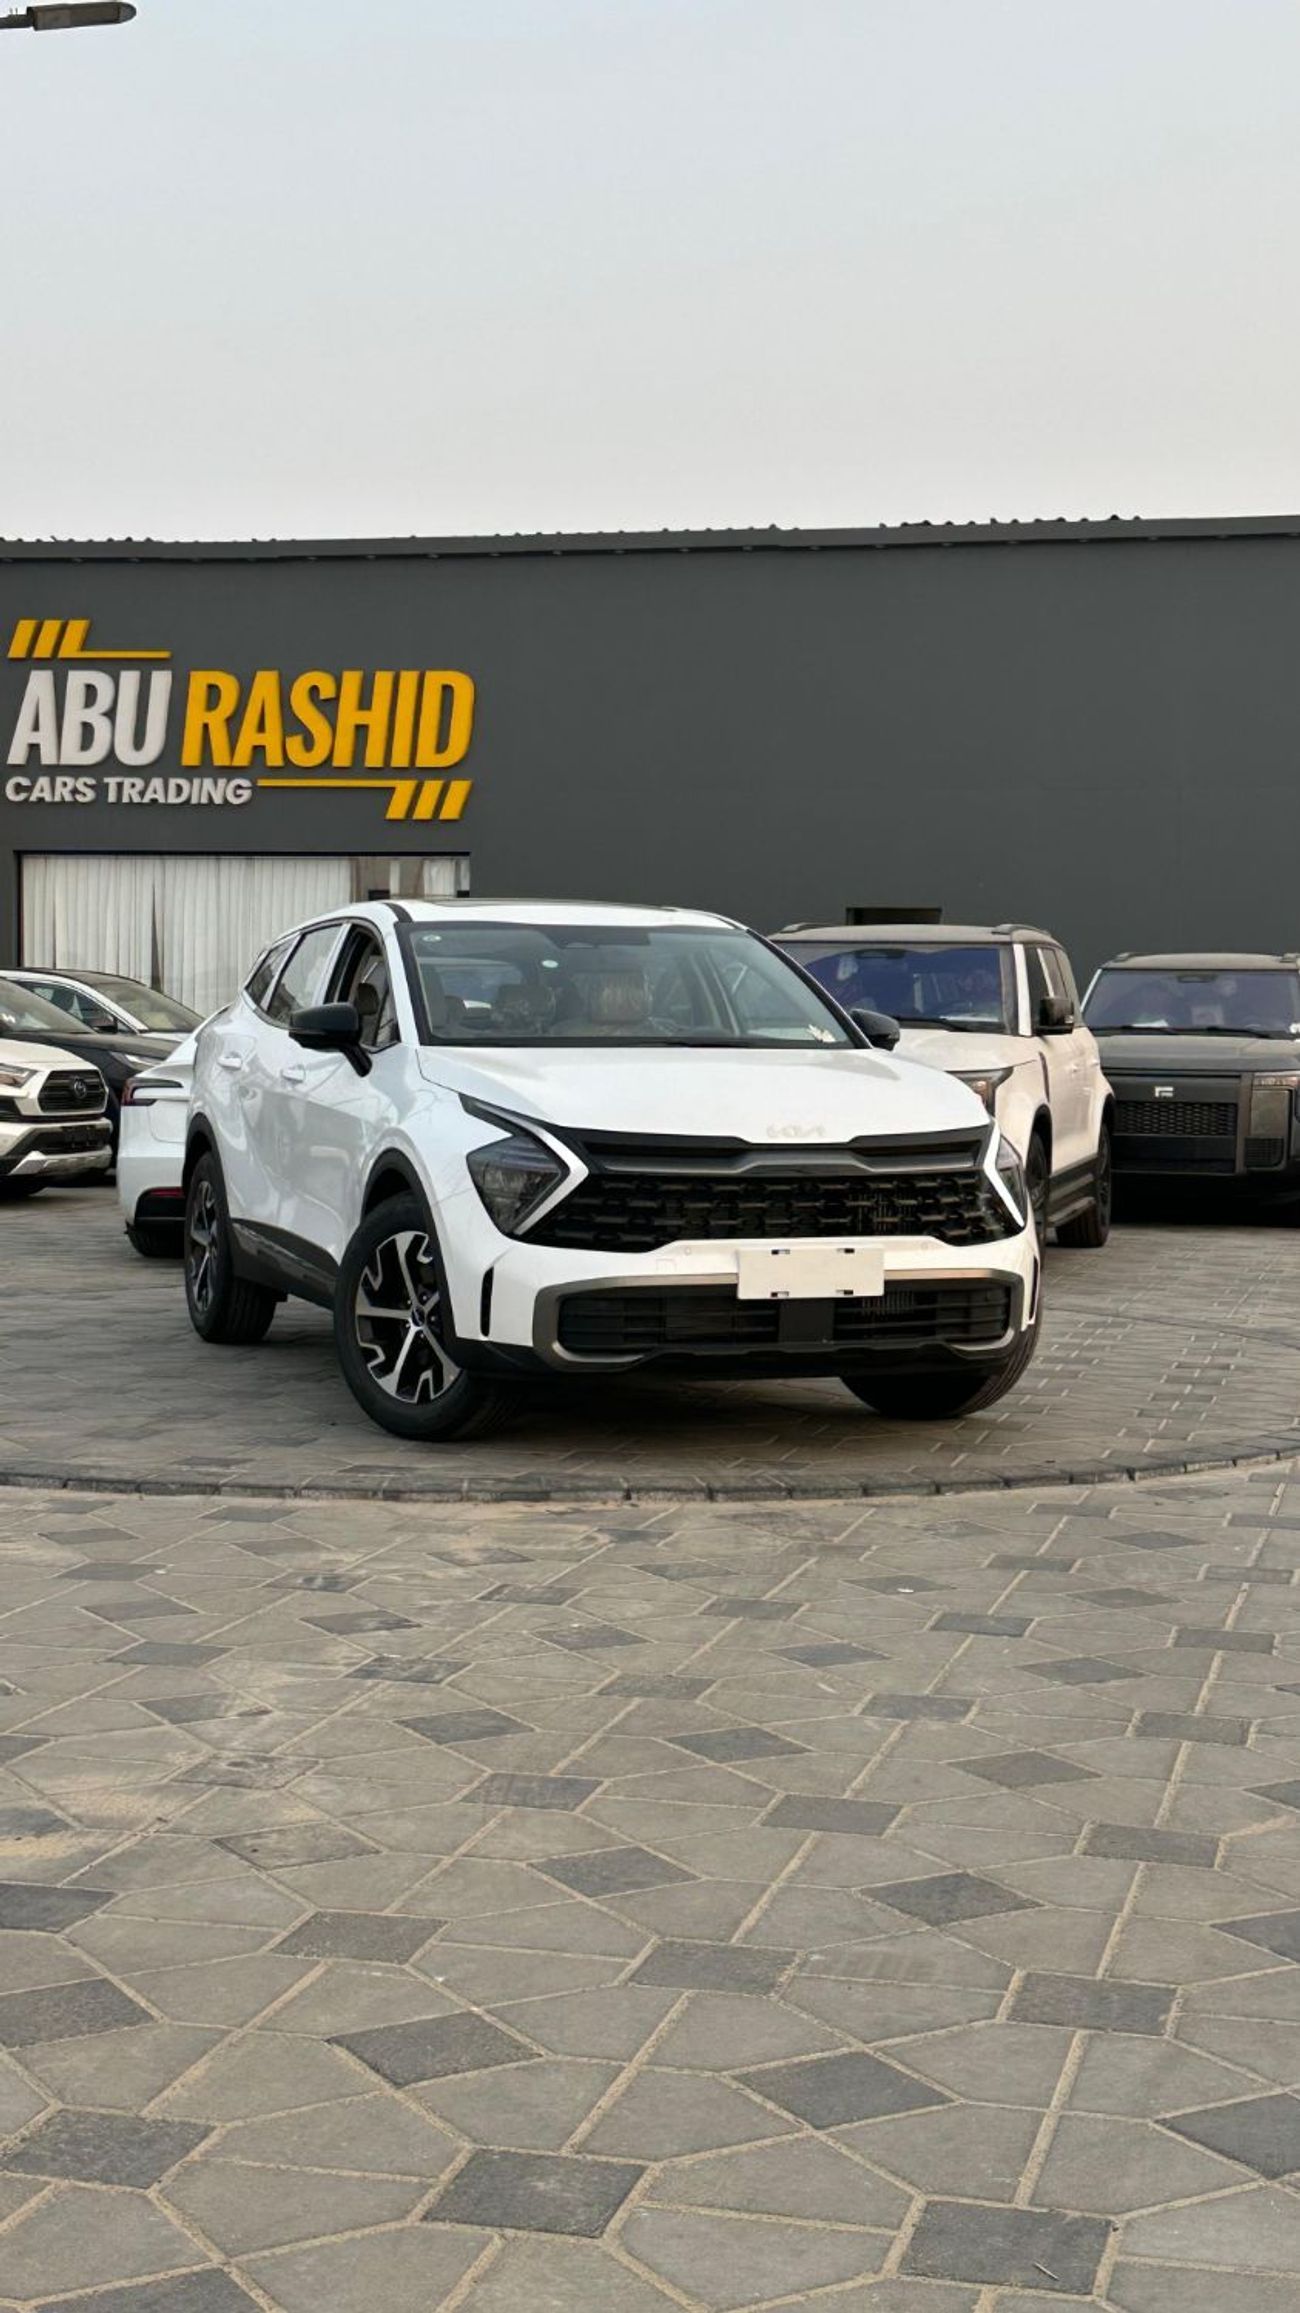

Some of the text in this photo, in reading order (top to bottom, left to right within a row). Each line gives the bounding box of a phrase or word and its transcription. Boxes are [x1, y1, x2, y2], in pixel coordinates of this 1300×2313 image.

[6, 669, 475, 769] ABU RASHID
[5, 776, 253, 805] CARS TRADING
